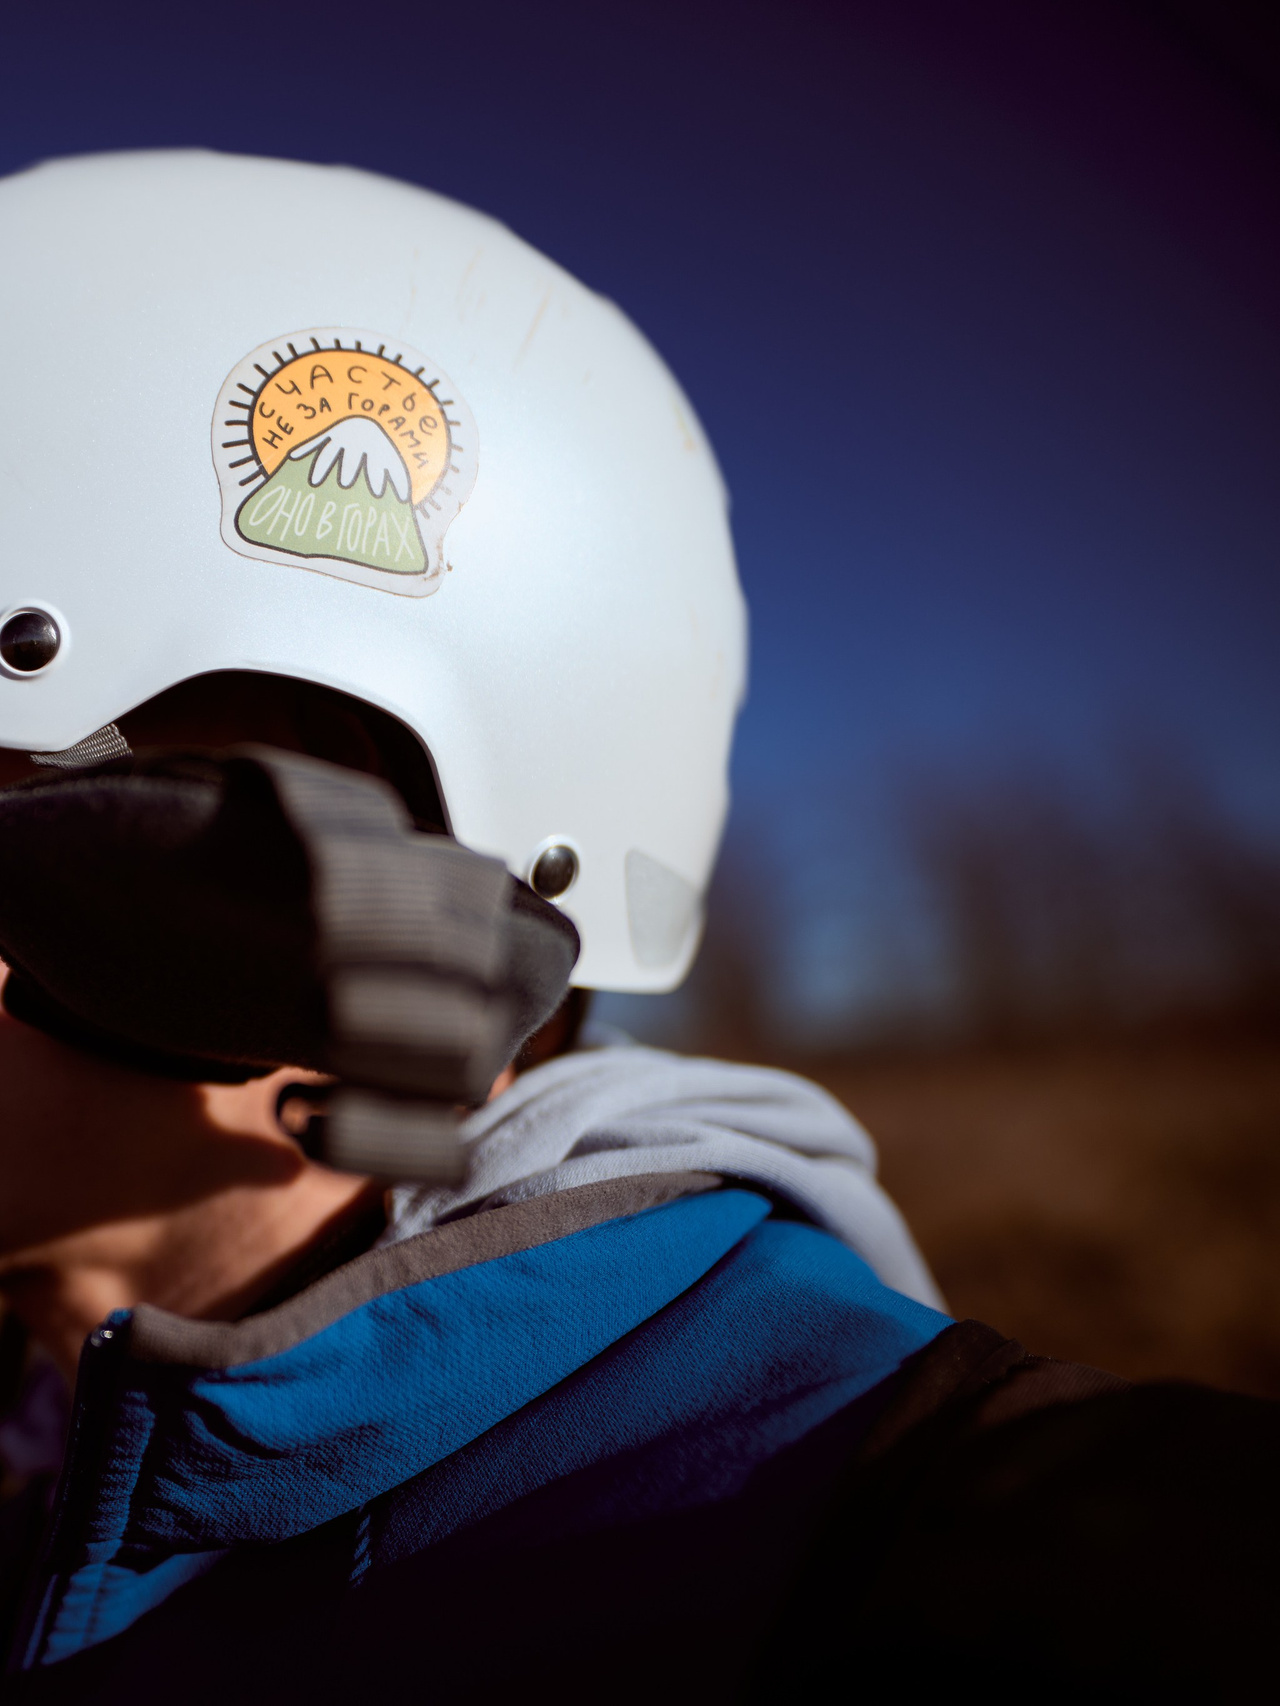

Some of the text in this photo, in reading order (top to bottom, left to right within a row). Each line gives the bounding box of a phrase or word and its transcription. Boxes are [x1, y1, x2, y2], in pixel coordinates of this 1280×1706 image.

[262, 392, 429, 470] НЕ ЗА ГОРАМИ
[248, 485, 415, 562] ОНО В ГОРАХ
